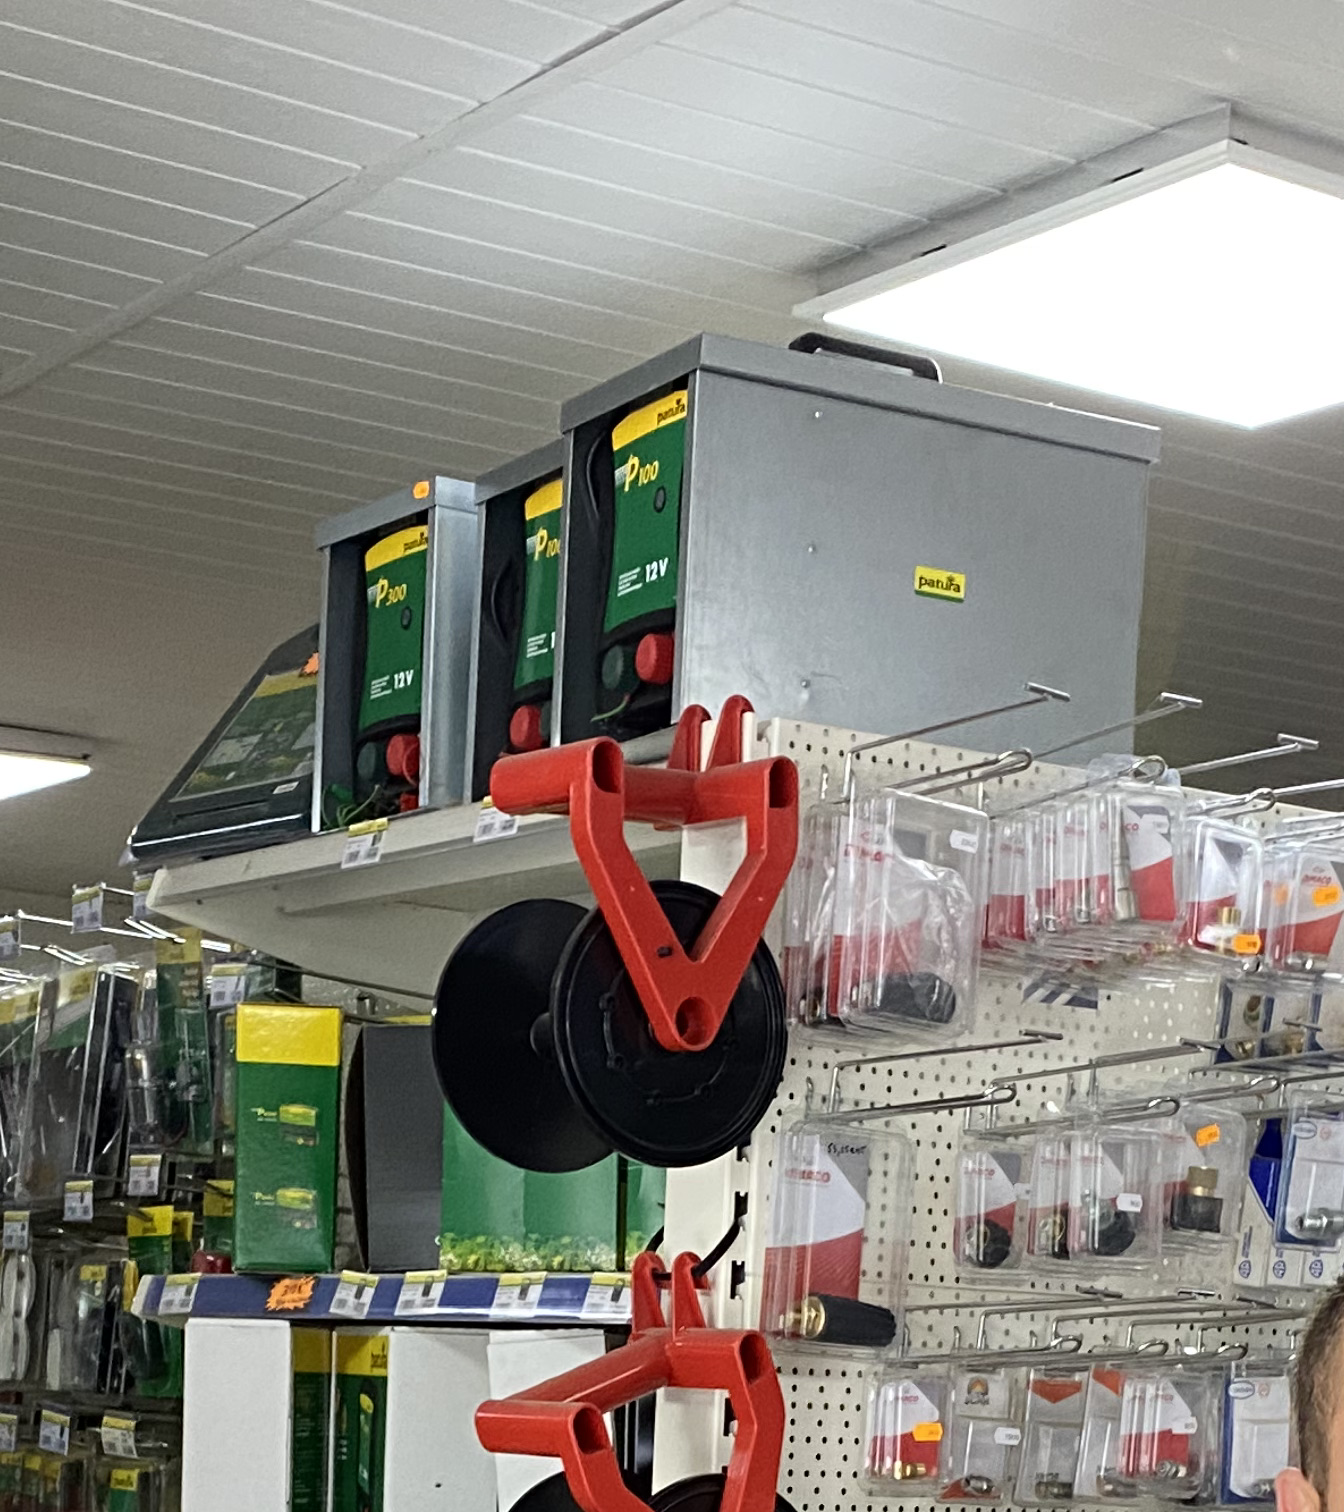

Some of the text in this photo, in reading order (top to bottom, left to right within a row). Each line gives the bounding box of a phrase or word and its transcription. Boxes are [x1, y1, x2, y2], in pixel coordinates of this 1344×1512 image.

[624, 454, 659, 491] P100
[645, 557, 668, 582] 12V
[375, 577, 407, 607] P300
[917, 573, 961, 595] patura
[393, 669, 414, 690] 12V
